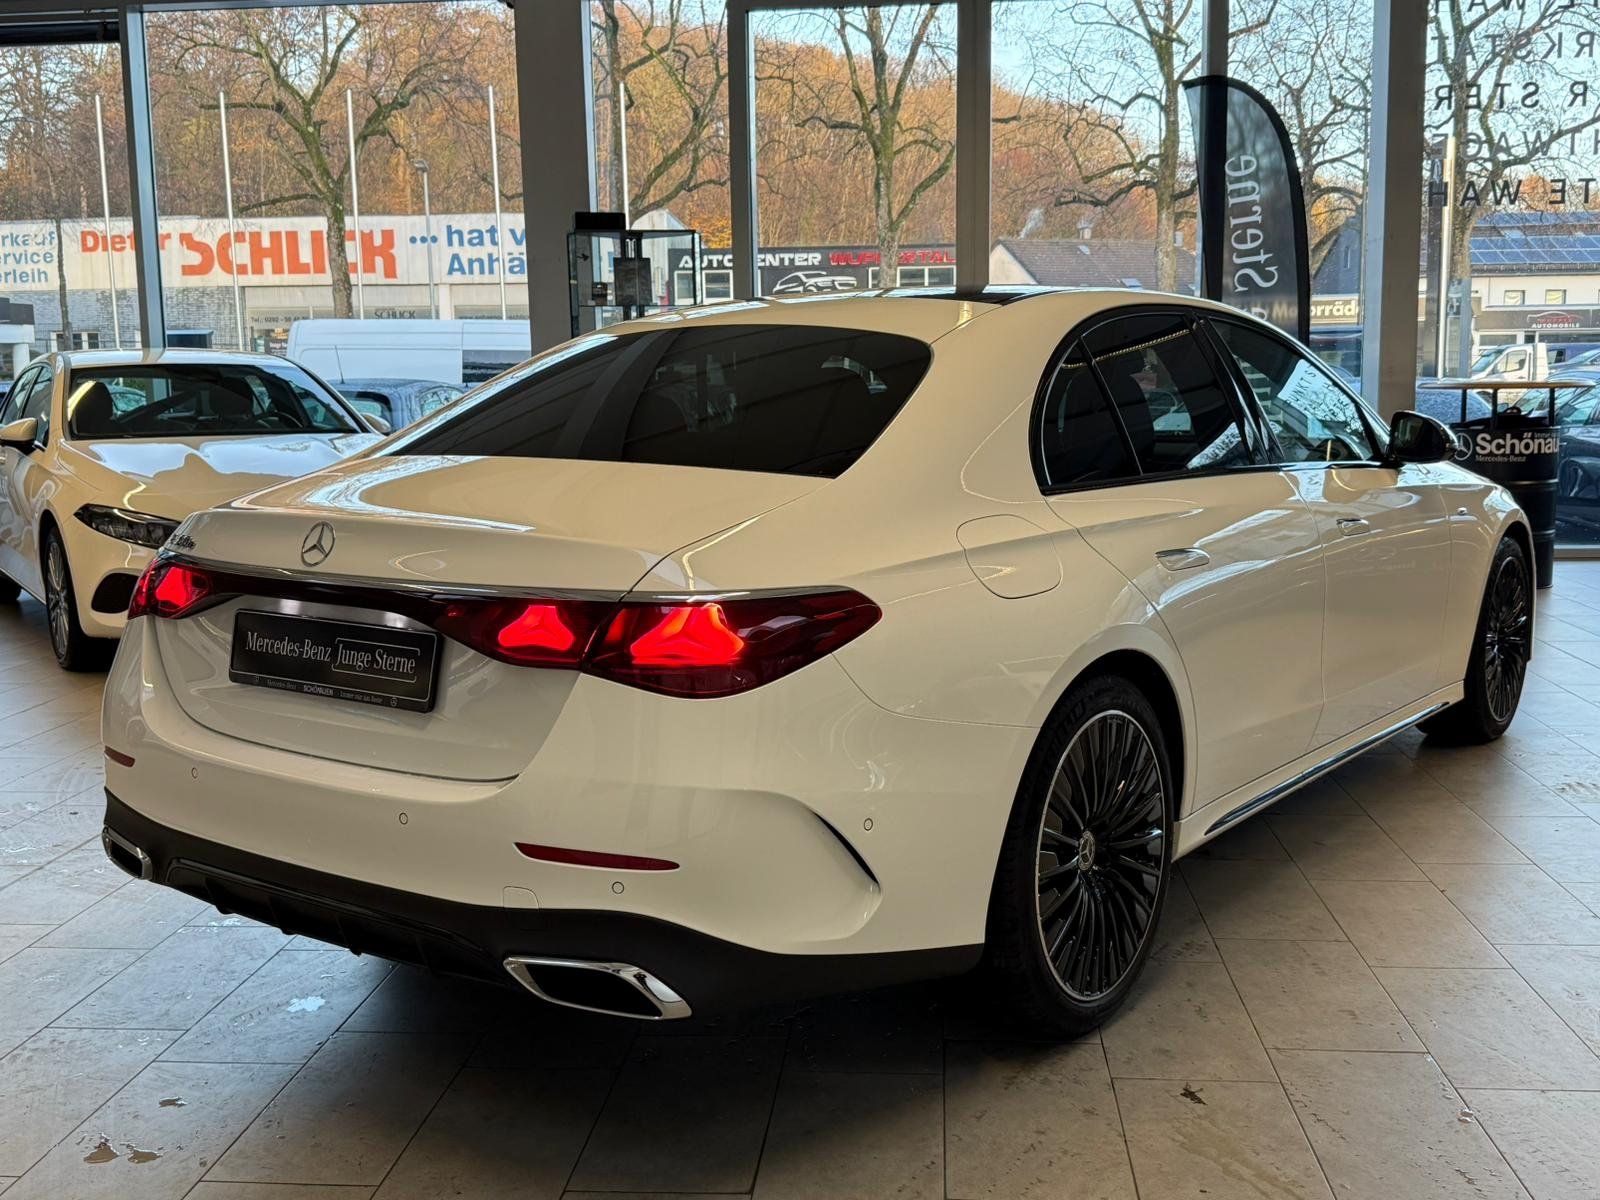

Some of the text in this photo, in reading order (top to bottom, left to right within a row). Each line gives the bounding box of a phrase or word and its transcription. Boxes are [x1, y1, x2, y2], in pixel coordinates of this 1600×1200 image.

[446, 225, 498, 247] hat
[246, 631, 417, 674] Mercedes-Benz Junge Sterne
